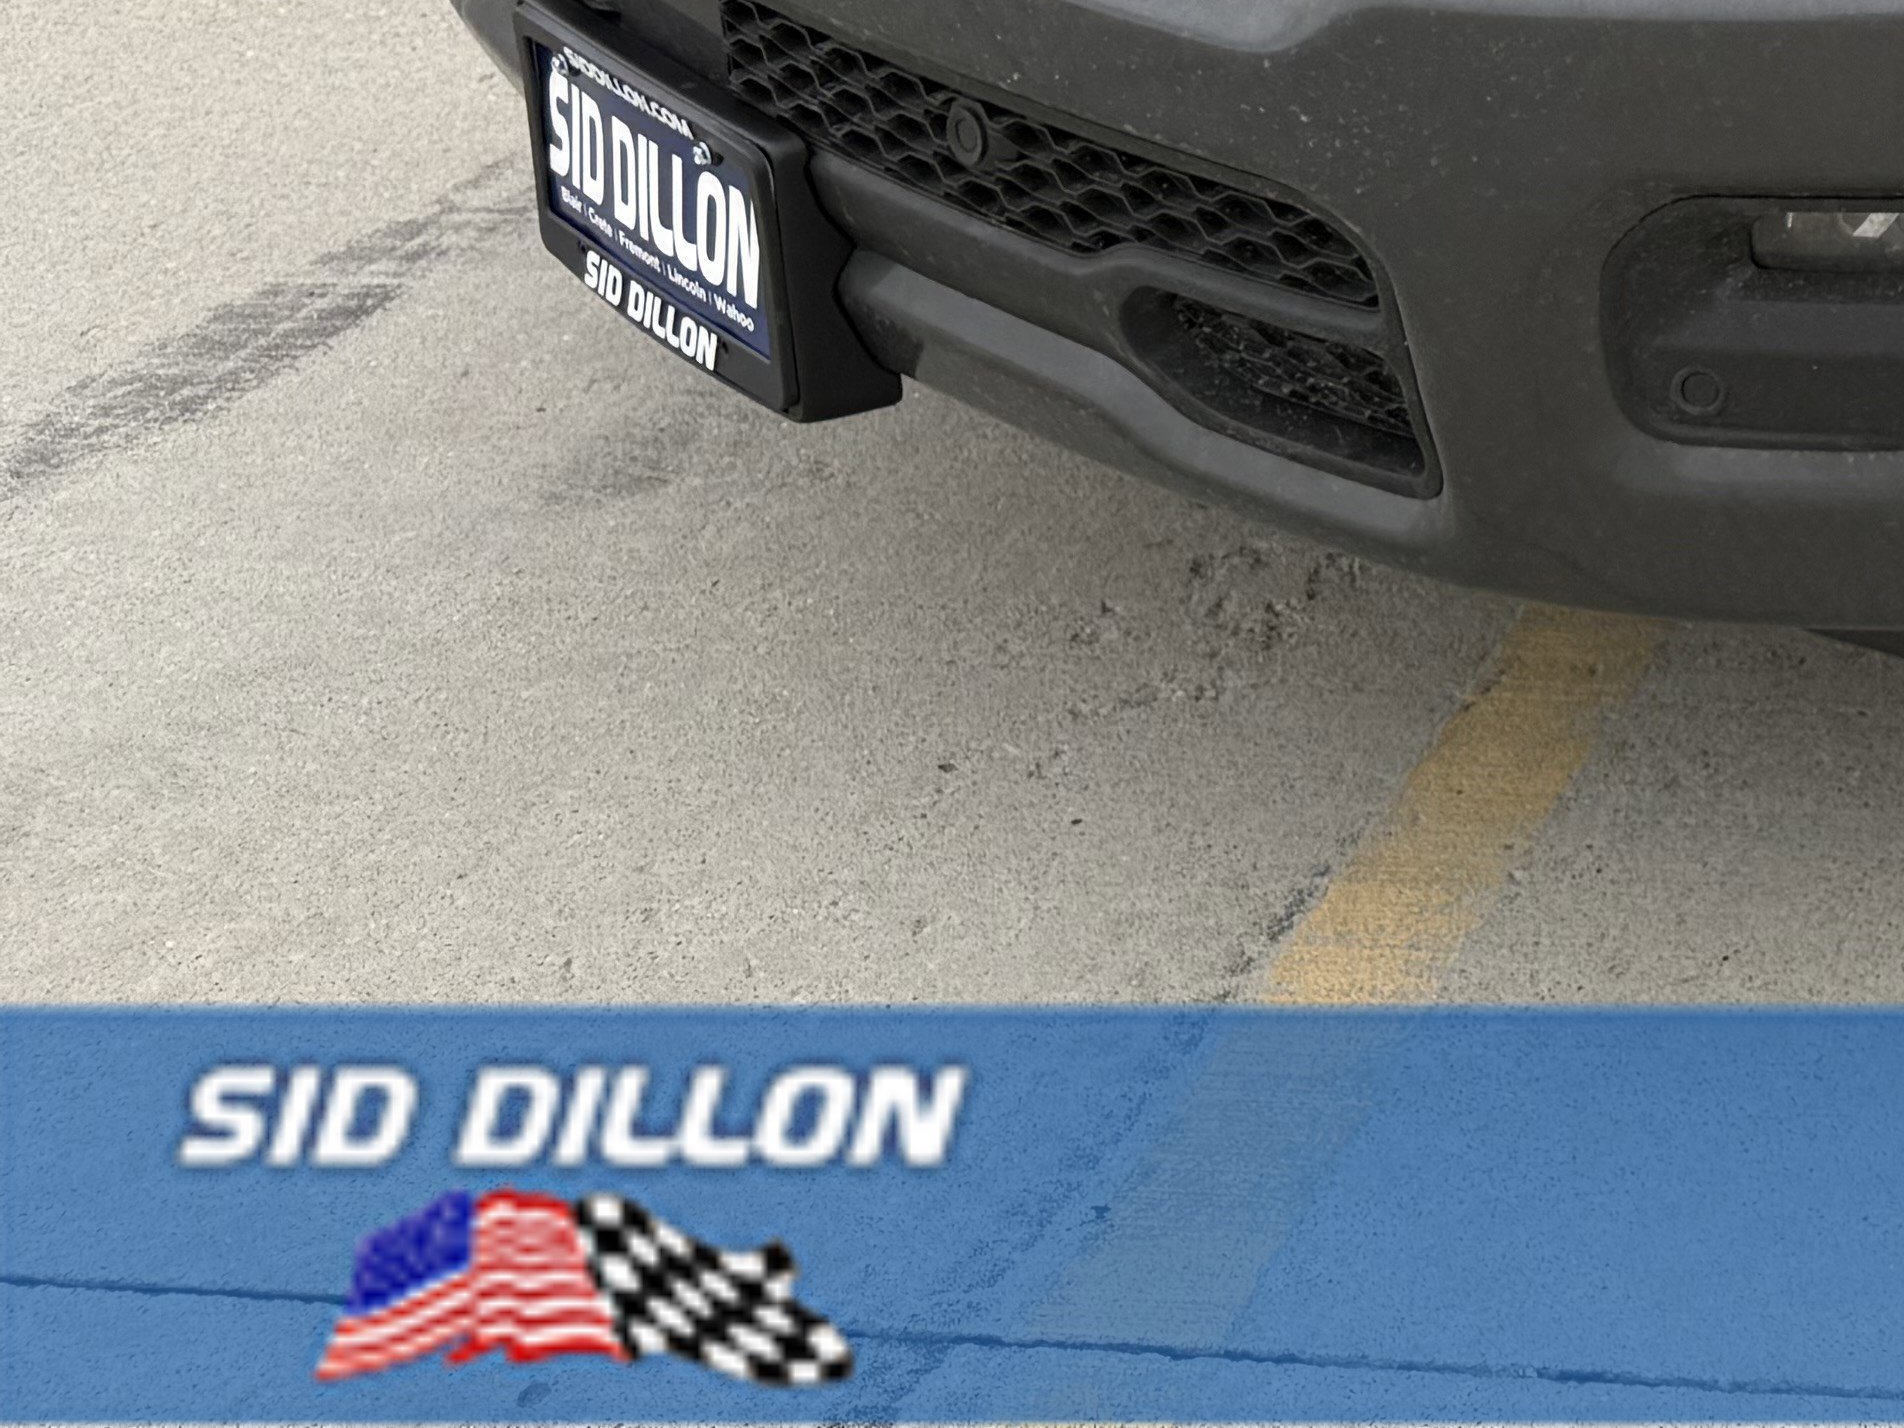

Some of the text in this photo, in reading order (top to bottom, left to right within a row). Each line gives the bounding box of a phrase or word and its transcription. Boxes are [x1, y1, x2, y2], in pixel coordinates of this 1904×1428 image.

[549, 71, 761, 310] SID DILLON
[583, 249, 718, 371] SID DILLON
[619, 230, 661, 274] Fremont
[667, 263, 707, 303] Lincoln
[713, 293, 755, 332] Wahoo
